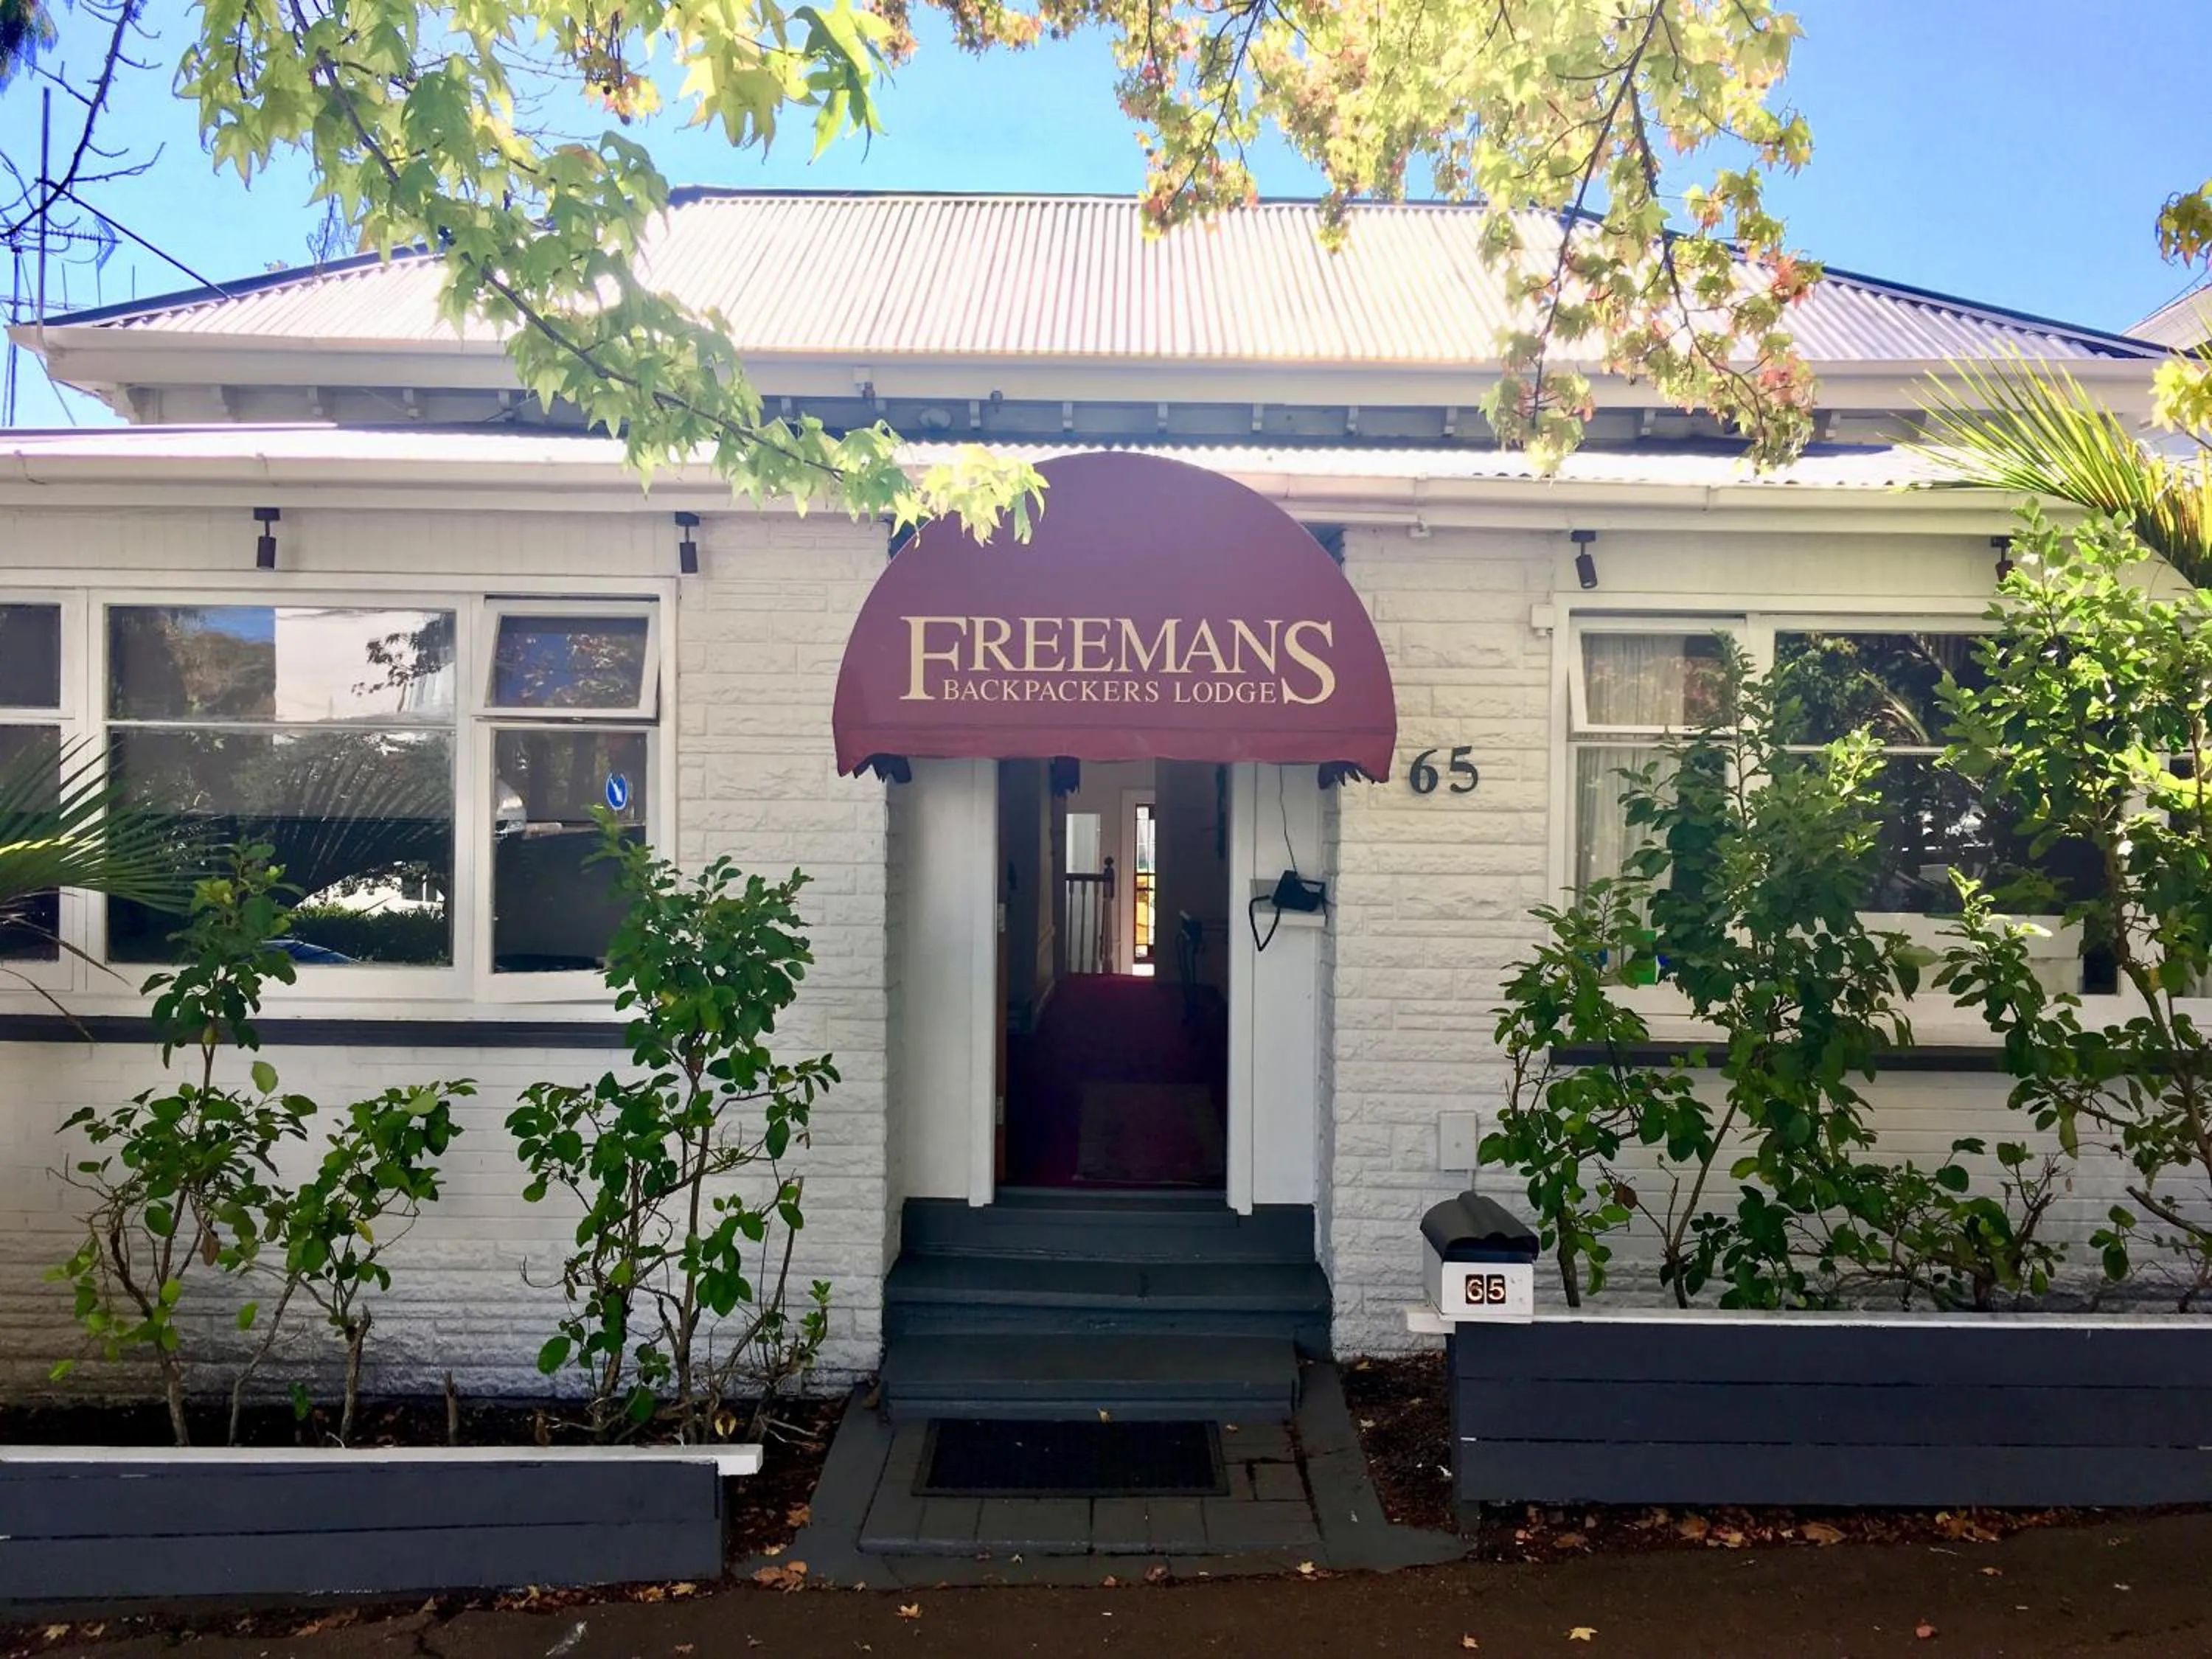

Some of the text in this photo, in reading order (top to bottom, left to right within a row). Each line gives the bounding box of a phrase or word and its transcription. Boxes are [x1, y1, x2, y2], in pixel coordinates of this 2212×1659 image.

[899, 615, 1336, 705] FREEMANS
[943, 678, 1276, 703] BACKPACKERS LODGE
[1409, 745, 1478, 794] 65
[1467, 1278, 1505, 1301] 65
